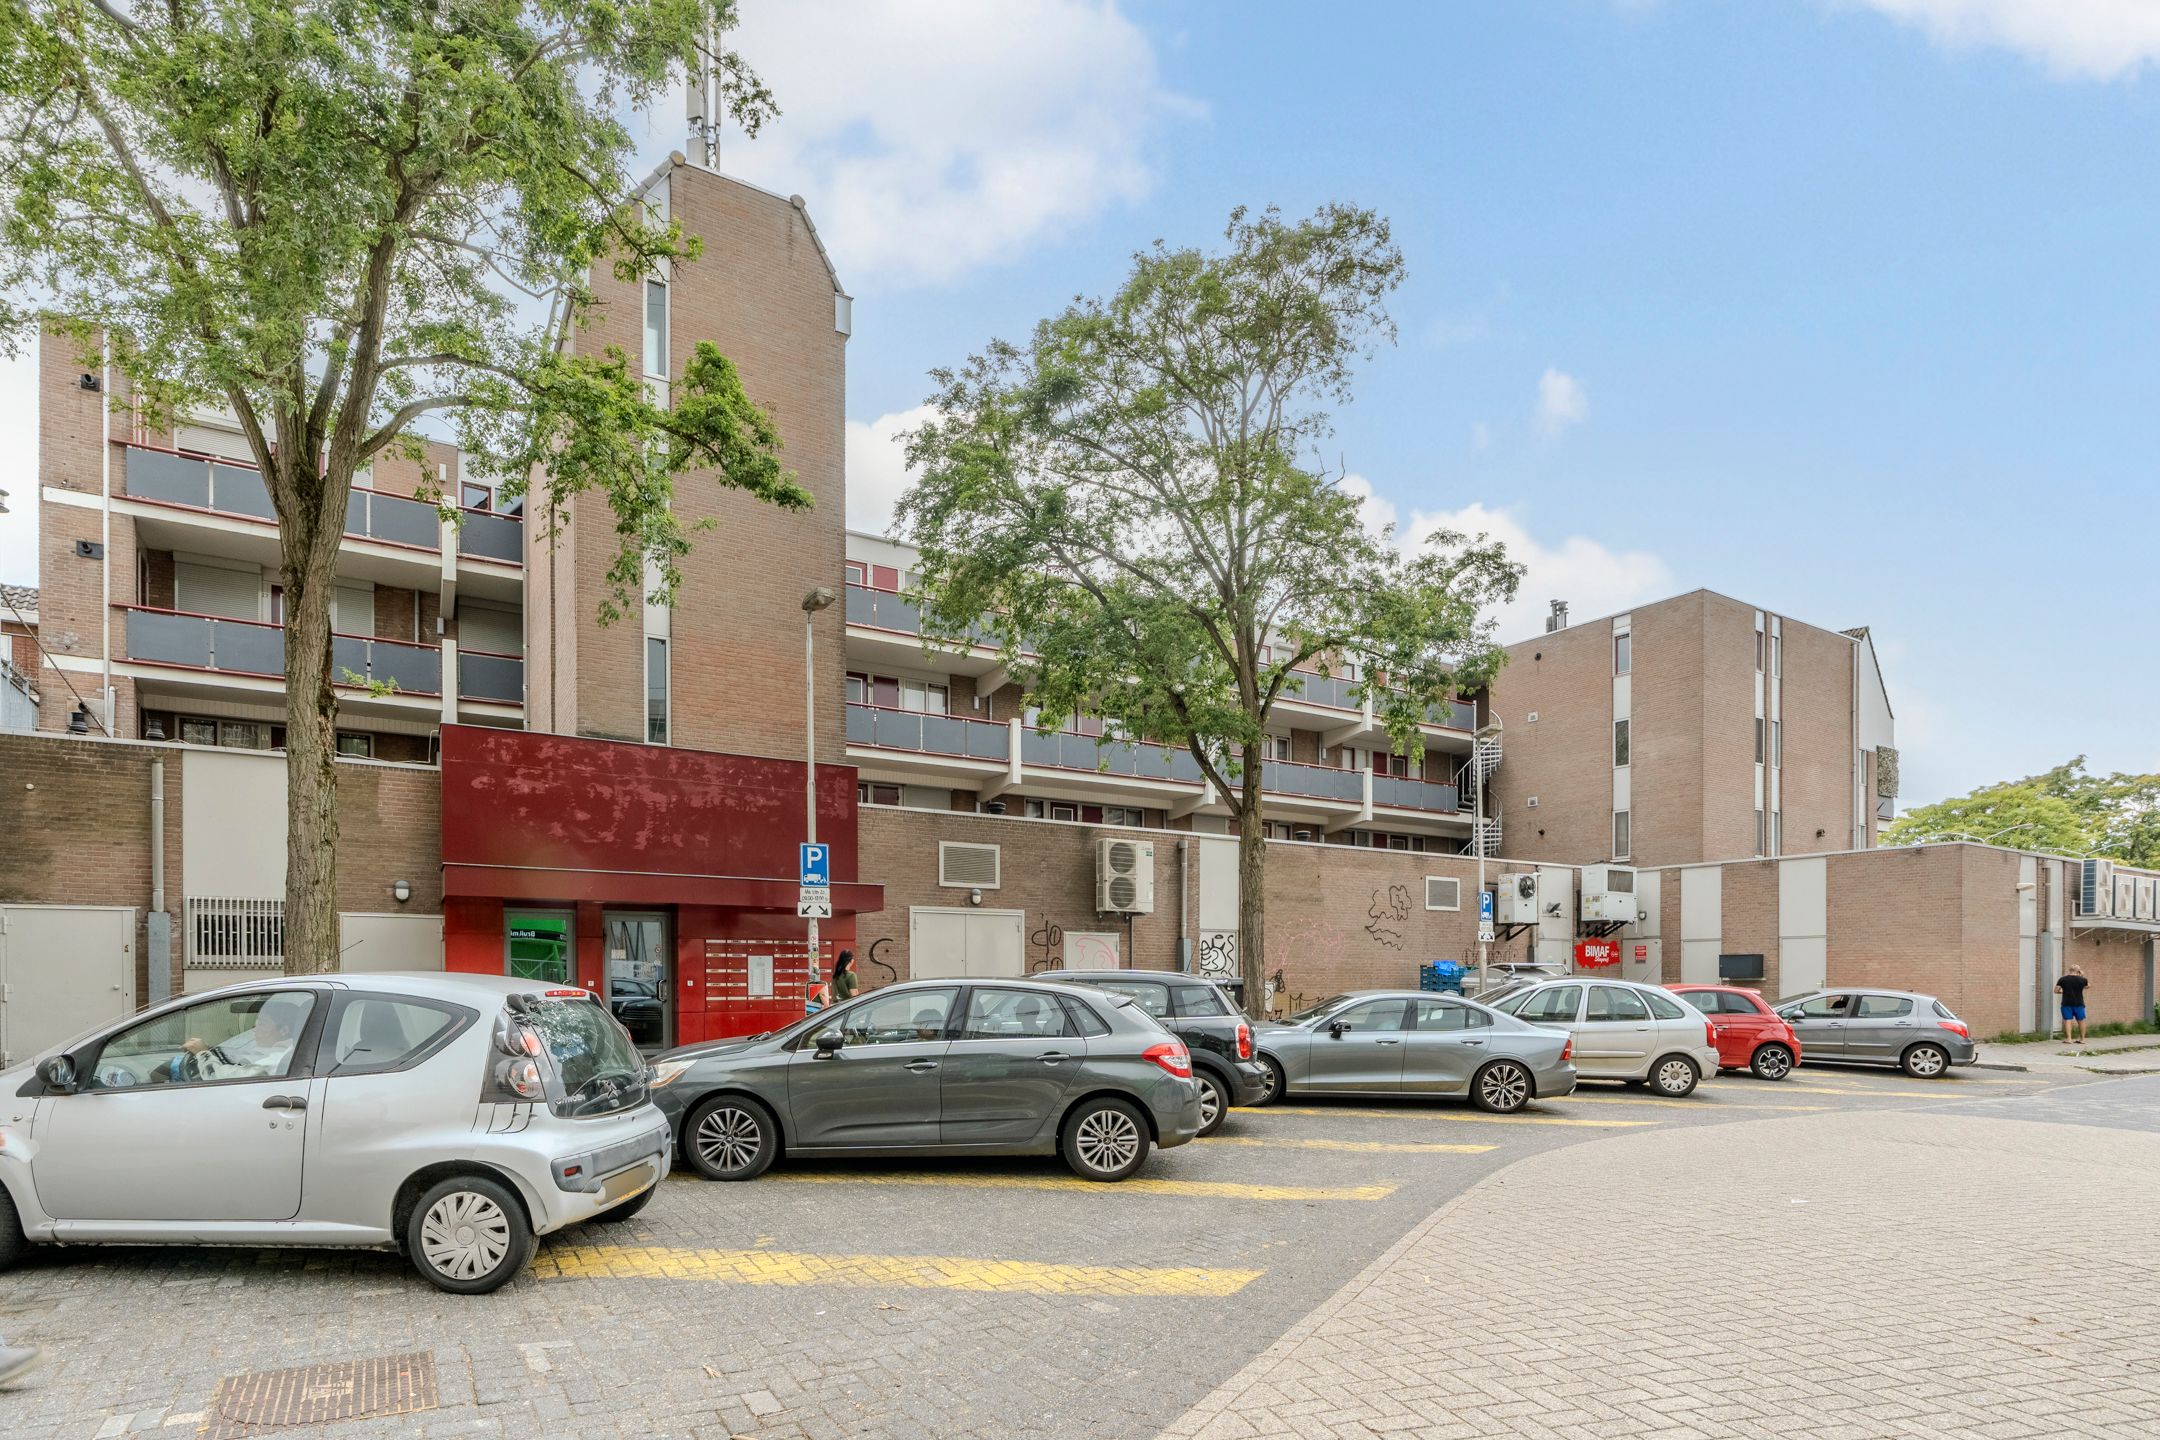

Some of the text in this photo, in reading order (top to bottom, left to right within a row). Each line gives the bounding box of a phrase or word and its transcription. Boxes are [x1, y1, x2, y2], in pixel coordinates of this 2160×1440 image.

[807, 847, 823, 869] P
[1482, 894, 1490, 909] P
[1585, 945, 1610, 957] BIMAF
